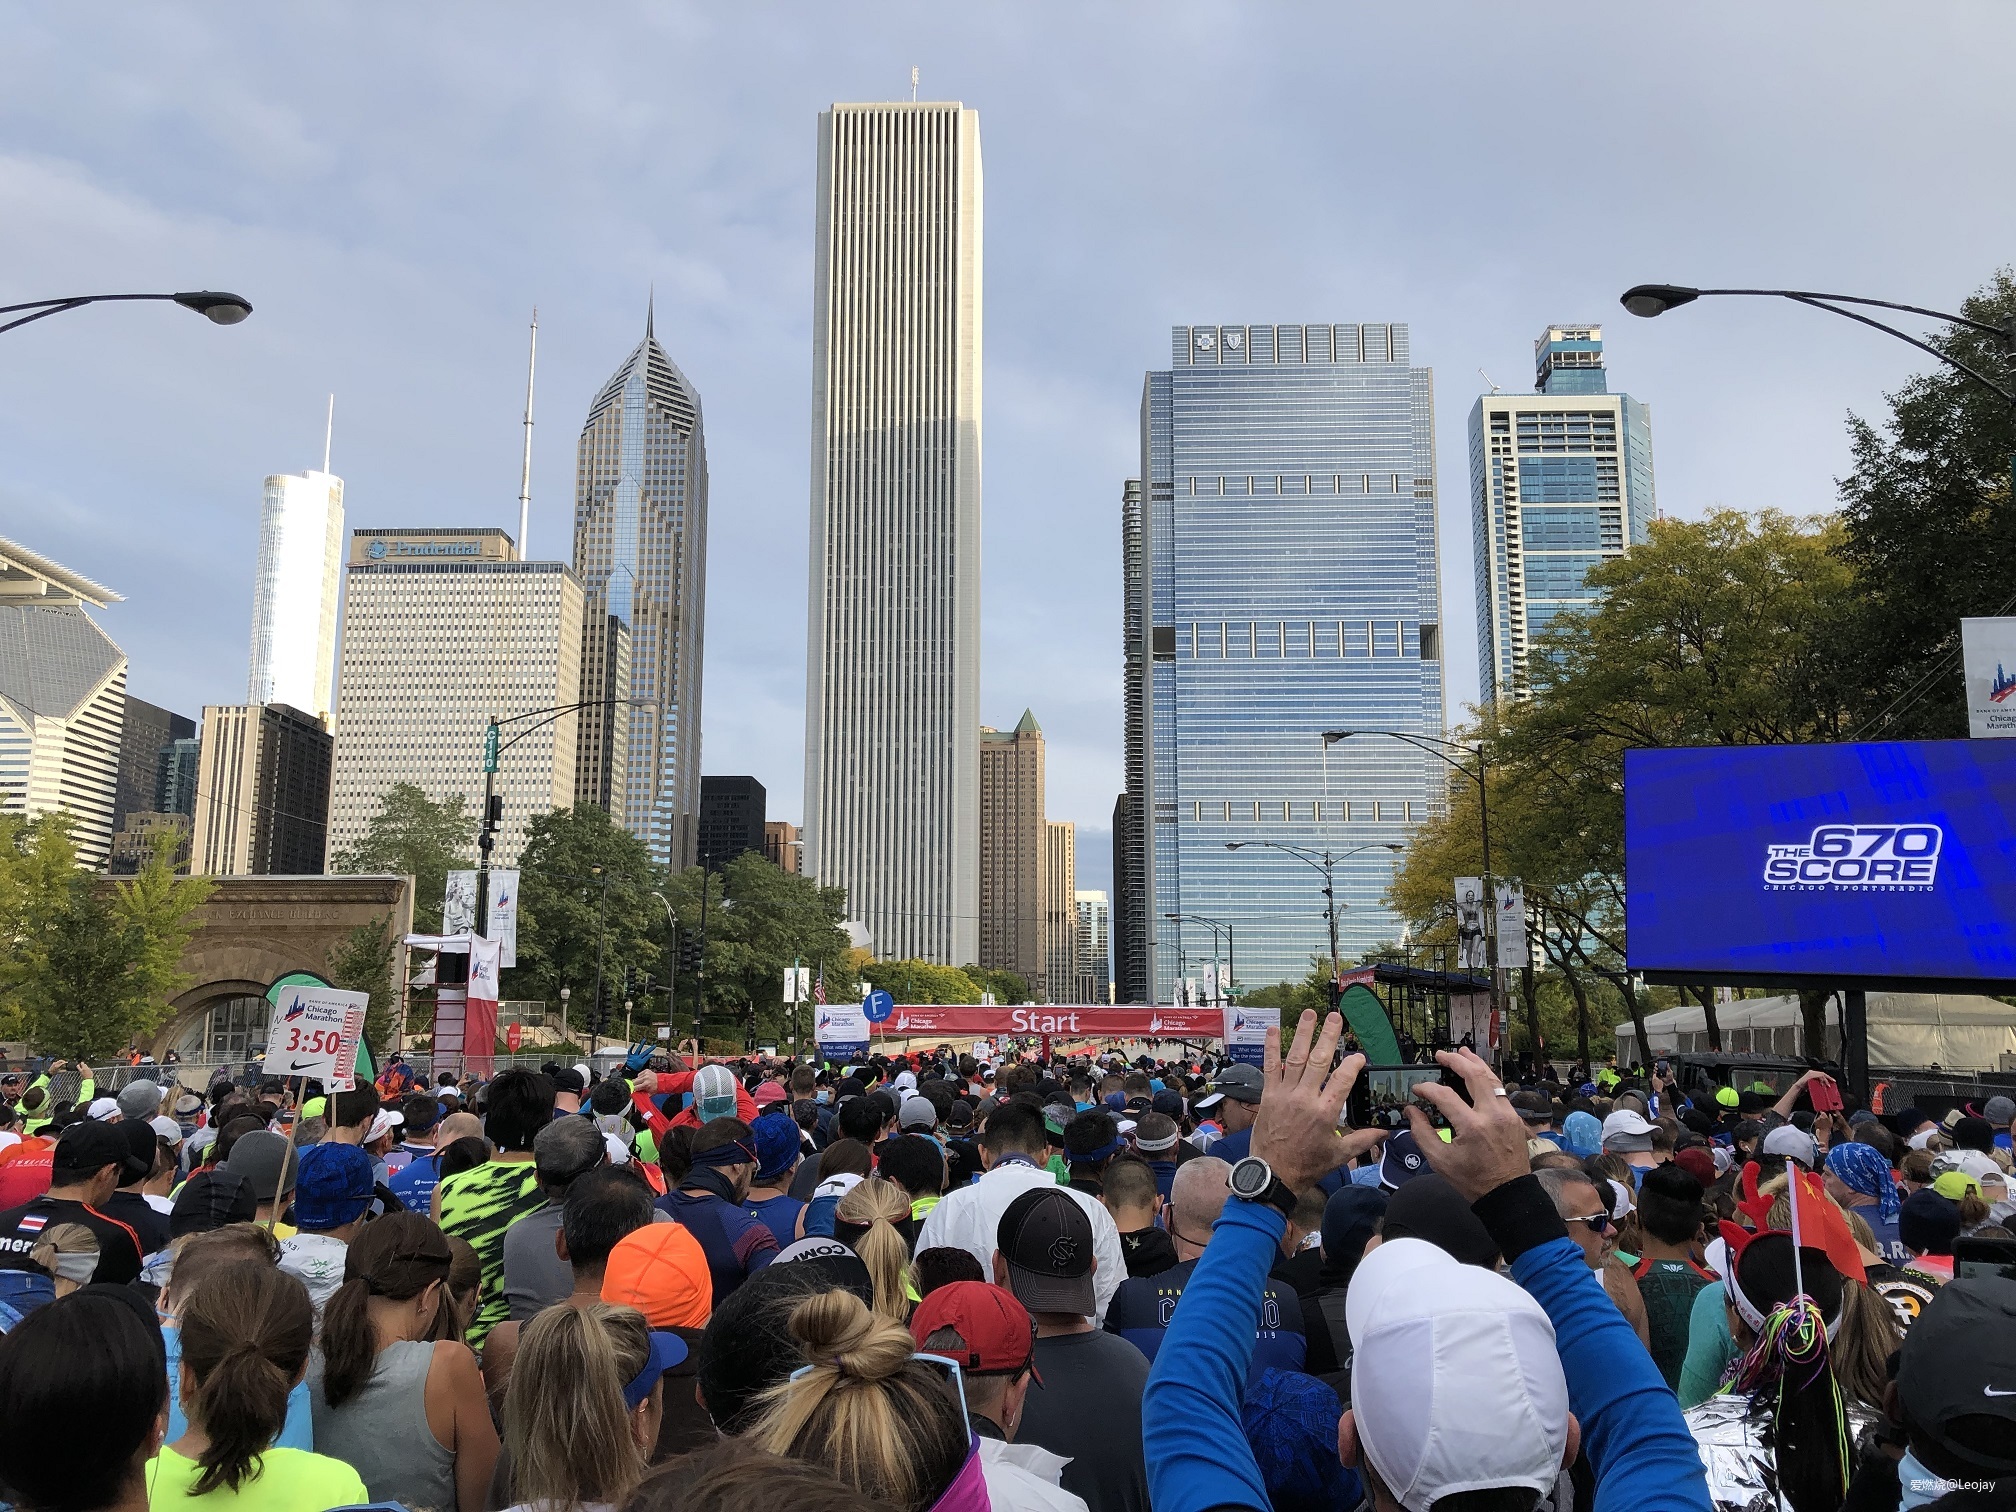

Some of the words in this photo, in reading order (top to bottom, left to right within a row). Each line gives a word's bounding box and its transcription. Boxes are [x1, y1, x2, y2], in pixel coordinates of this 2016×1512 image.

[396, 540, 480, 556] Prudential
[1986, 722, 2016, 730] Marath
[486, 730, 496, 768] C110
[1772, 848, 1810, 858] THE
[1812, 827, 1939, 858] 670
[1768, 859, 1934, 882] SCORE
[306, 1005, 338, 1017] Chicago
[871, 993, 884, 1014] F
[304, 1013, 343, 1023] Marathon
[1011, 1009, 1080, 1033] Start
[286, 1027, 342, 1055] 3:50
